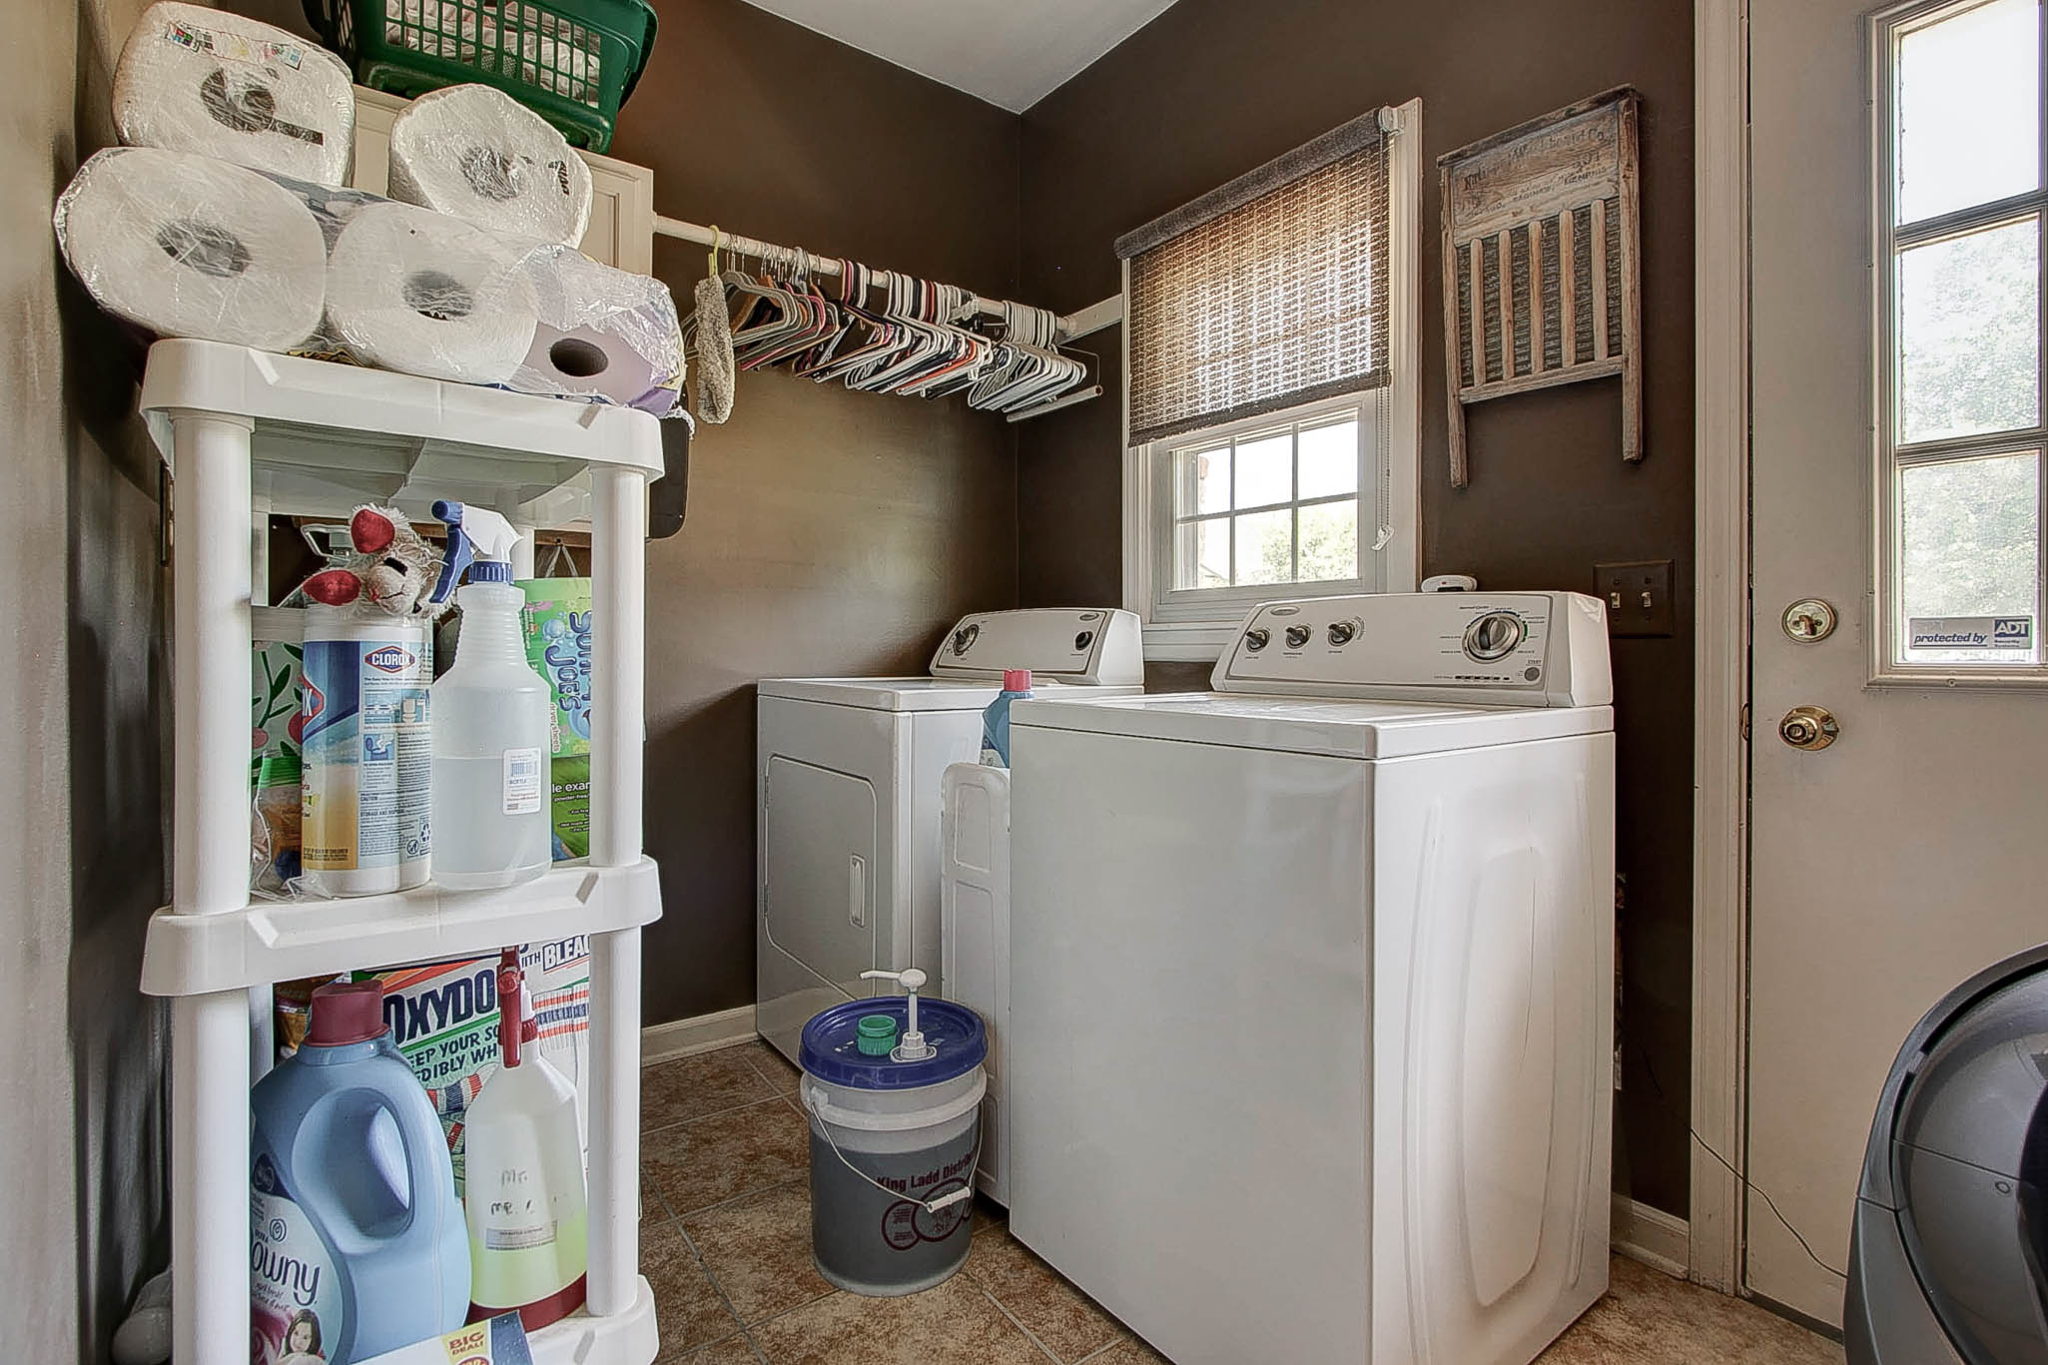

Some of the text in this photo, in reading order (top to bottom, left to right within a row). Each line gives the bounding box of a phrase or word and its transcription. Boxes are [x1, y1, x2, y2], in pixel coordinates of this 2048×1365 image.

[1914, 632, 1988, 643] protected by
[1994, 621, 2029, 635] ADT
[371, 653, 412, 666] CLOROX
[545, 645, 582, 711] JOE'S
[552, 726, 561, 752] sheets
[382, 968, 500, 1045] OXYDO
[407, 1047, 436, 1068] EEP
[440, 1030, 481, 1057] YOUR
[415, 1044, 498, 1083] EDIBLY WH
[911, 1168, 940, 1188] Ladd
[252, 1241, 321, 1307] owny
[449, 1331, 485, 1350] BIG
[452, 1340, 484, 1356] DEAL!
